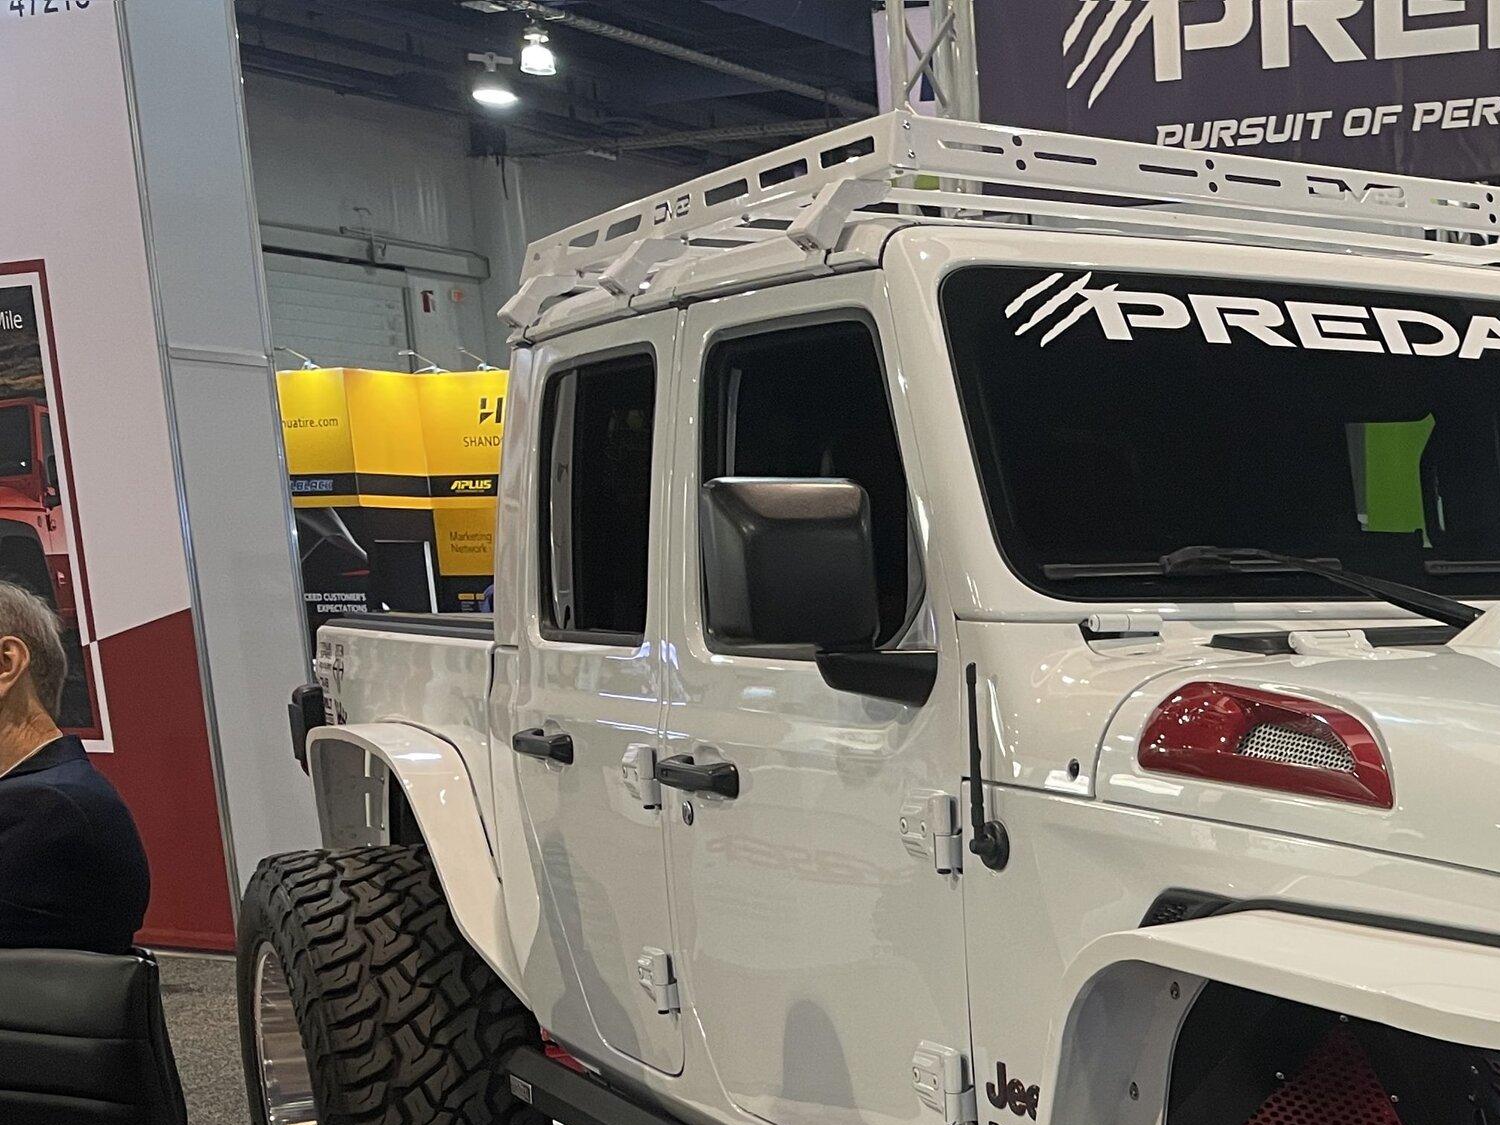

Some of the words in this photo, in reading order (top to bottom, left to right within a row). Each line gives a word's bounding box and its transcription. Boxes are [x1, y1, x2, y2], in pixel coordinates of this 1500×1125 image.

[1156, 110, 1333, 150] PURSUIT
[1342, 104, 1403, 138] OF
[462, 434, 504, 448] SHAND
[449, 531, 492, 544] Marketing
[451, 544, 488, 554] Network
[985, 1061, 1041, 1121] Jee
